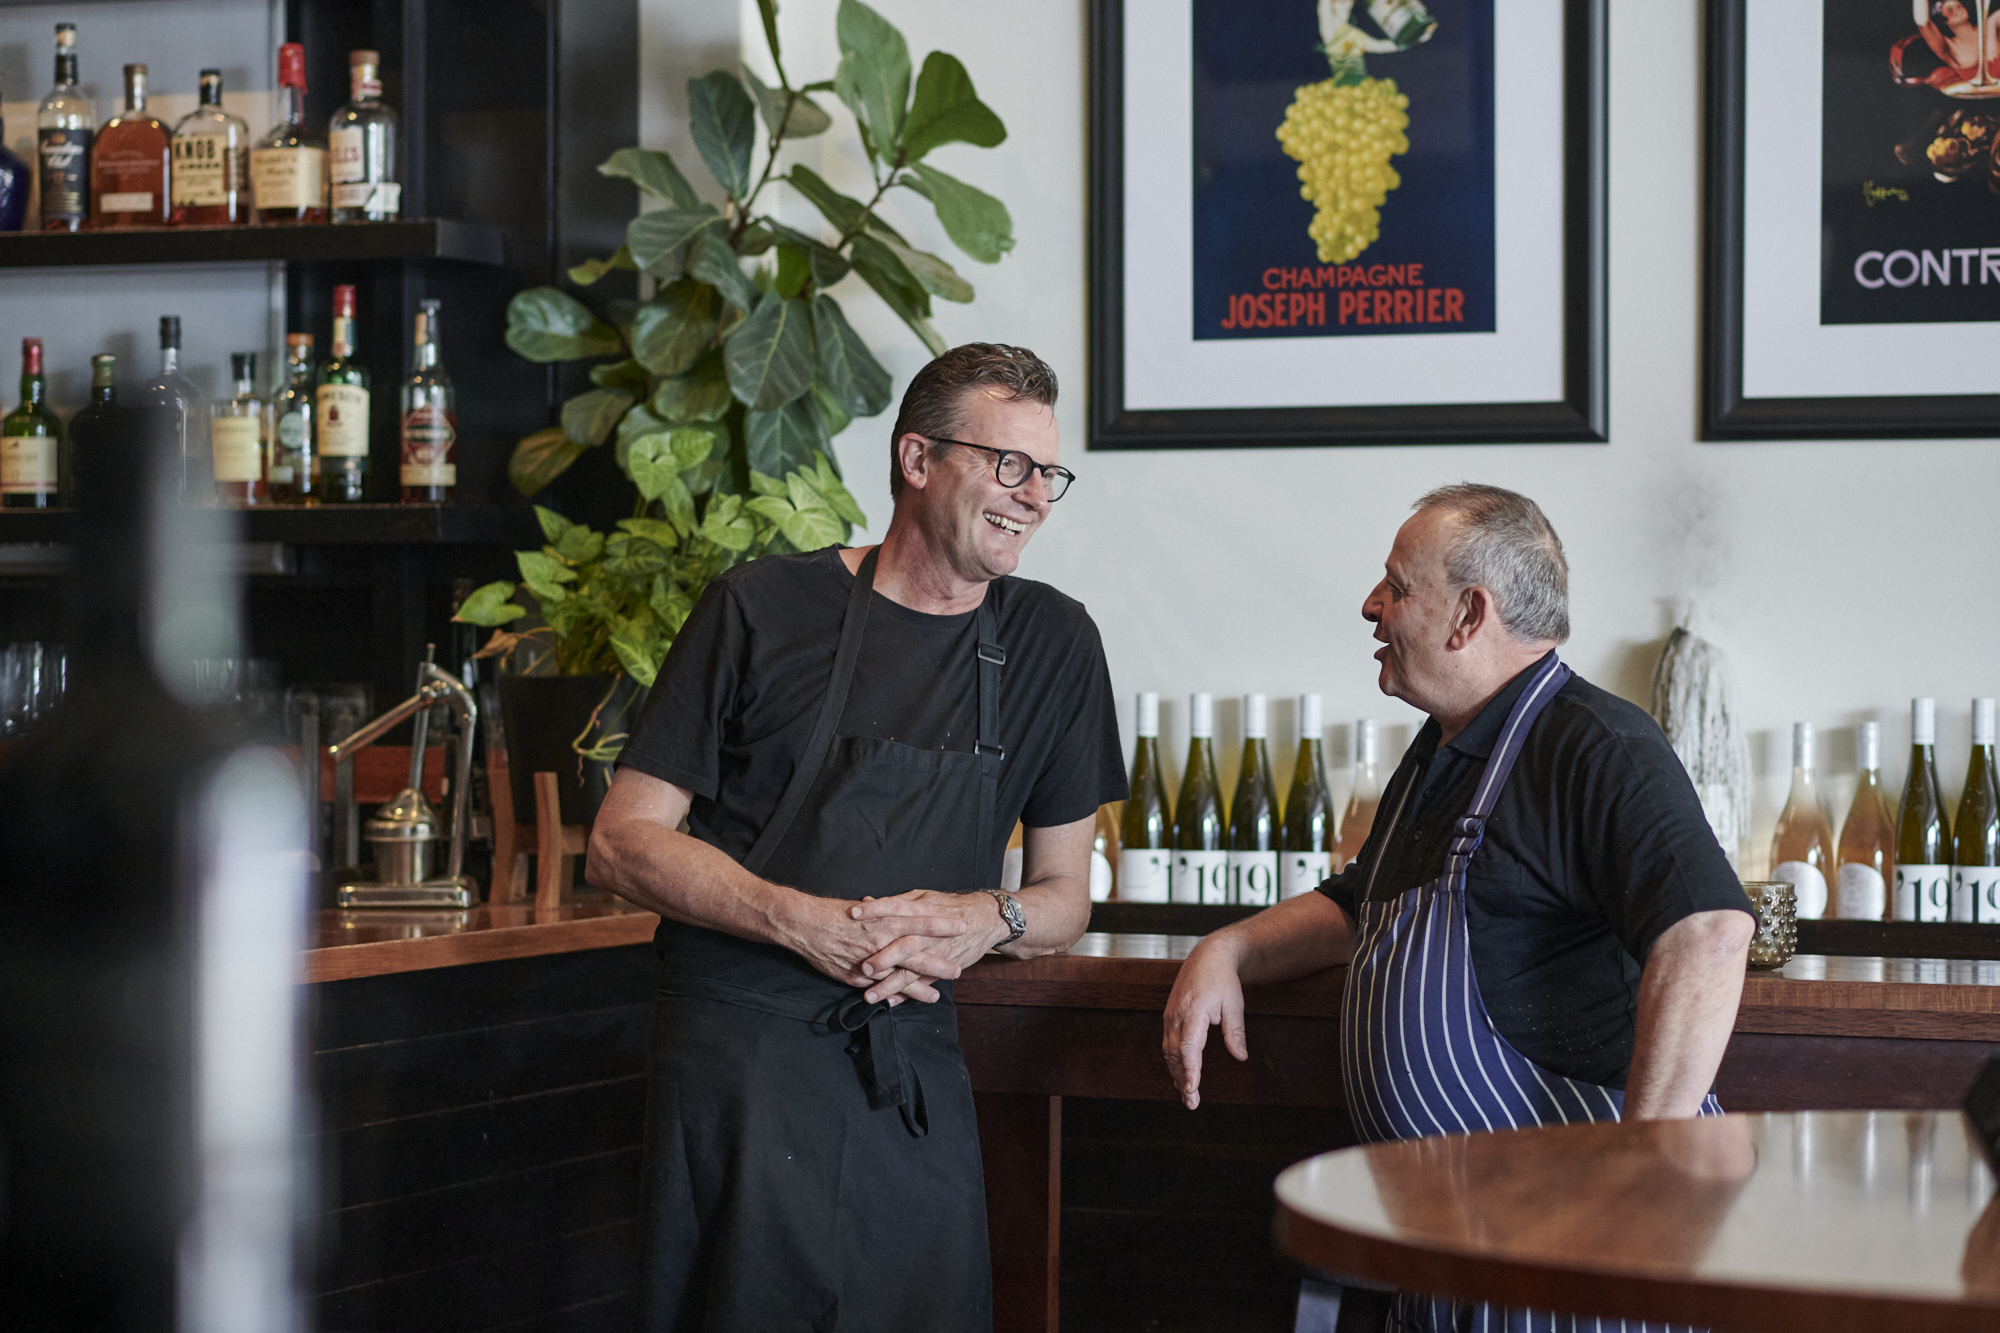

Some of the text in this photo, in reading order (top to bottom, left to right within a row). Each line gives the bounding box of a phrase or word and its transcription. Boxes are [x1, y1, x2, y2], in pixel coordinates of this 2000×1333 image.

[175, 139, 215, 159] KNOB
[1262, 263, 1424, 290] CHAMPAGNE
[1221, 287, 1464, 330] JOSEPH PERRIER
[1896, 870, 1952, 923] '19
